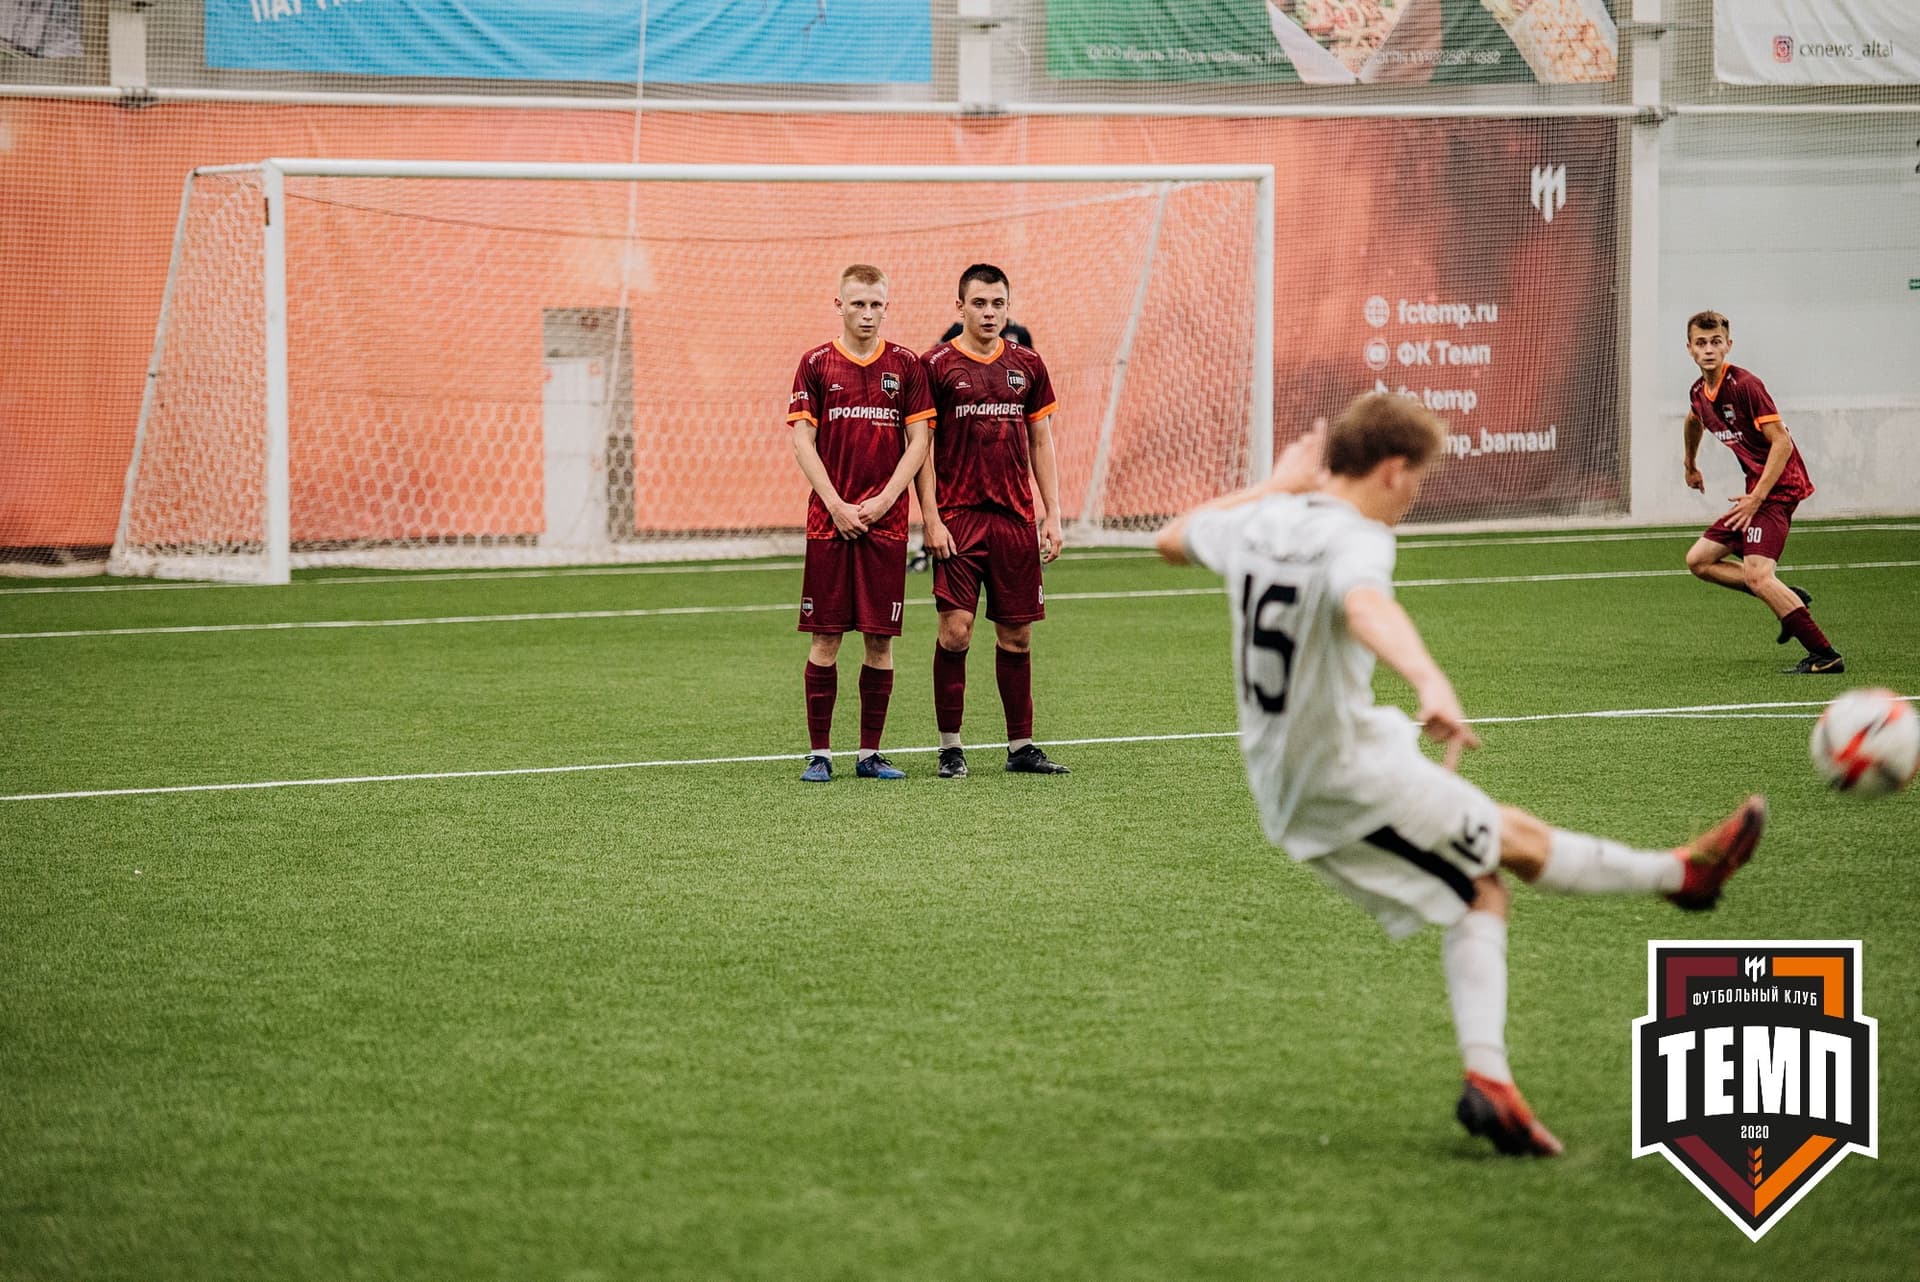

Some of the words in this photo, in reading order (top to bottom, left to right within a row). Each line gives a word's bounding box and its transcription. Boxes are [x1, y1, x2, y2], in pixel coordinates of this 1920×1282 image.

[1397, 299, 1499, 330] fctemp.ru
[1397, 341, 1432, 367] ФК
[1434, 338, 1492, 366] Темп
[1746, 527, 1763, 543] 30
[891, 601, 902, 622] 17
[1242, 573, 1297, 714] 15
[1451, 813, 1491, 866] 15
